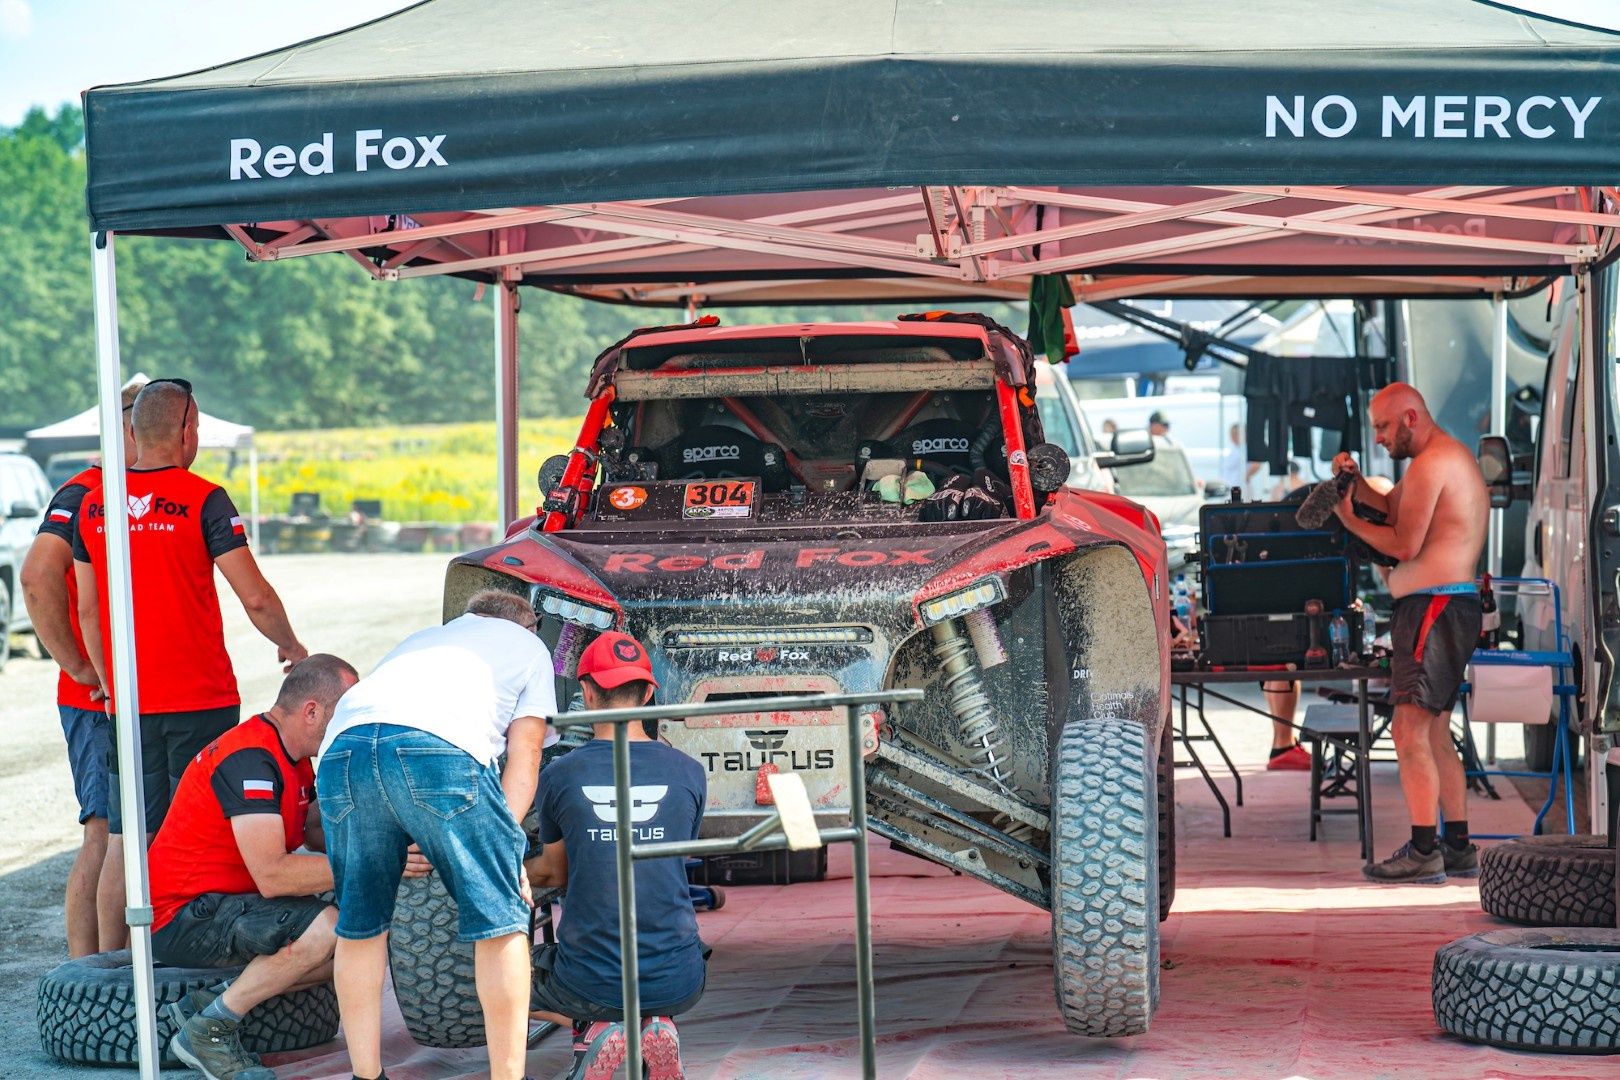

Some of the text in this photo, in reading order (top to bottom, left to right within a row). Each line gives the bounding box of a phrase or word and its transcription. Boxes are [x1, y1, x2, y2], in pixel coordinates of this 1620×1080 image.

[1265, 95, 1603, 139] NO MERCY
[230, 128, 449, 181] Red Fox
[683, 445, 740, 461] sparco
[912, 436, 969, 454] sparco
[689, 484, 748, 505] 304
[154, 498, 188, 518] Fox
[148, 523, 175, 532] TEAM
[603, 548, 935, 573] Red Fox
[718, 649, 810, 662] Red Fox
